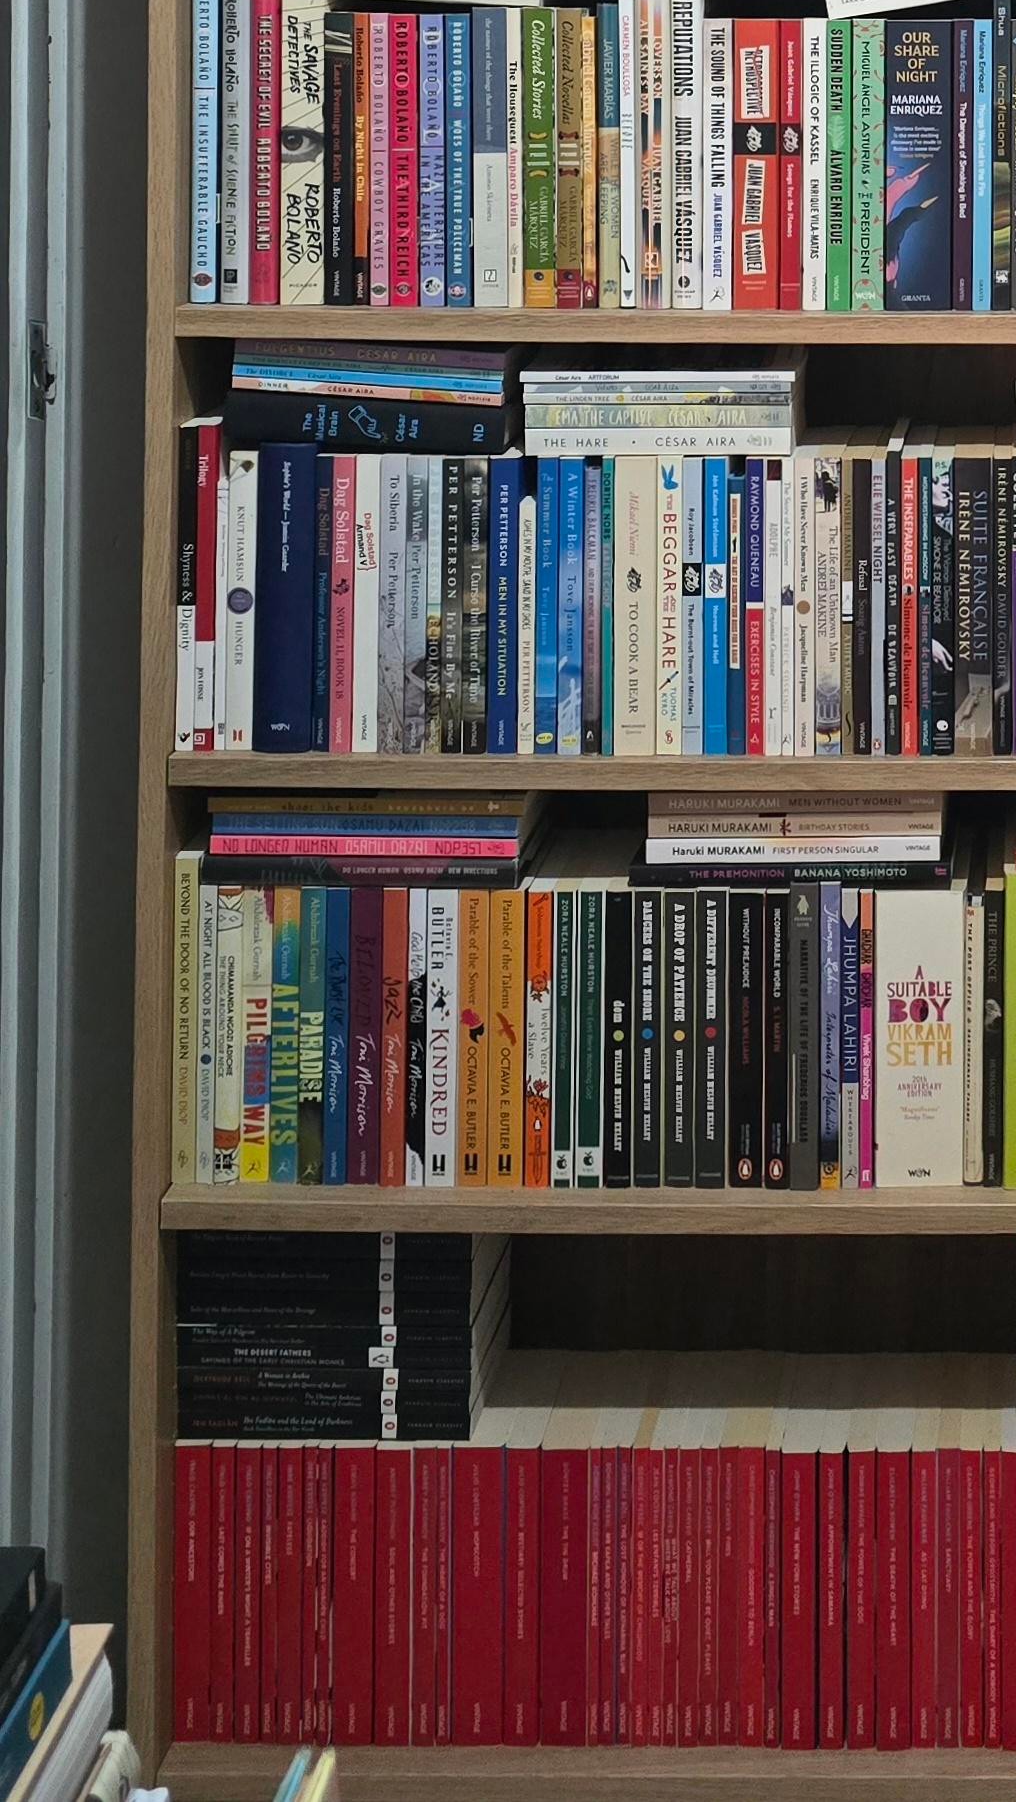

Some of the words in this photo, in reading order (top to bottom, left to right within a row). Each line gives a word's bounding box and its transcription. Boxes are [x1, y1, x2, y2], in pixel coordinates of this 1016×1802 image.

[902, 32, 931, 44] OUR
[672, 1, 692, 97] REPUTATIONS
[894, 45, 940, 57] SHARE
[907, 58, 925, 70] OF
[895, 70, 938, 84] NIGHT
[891, 95, 941, 105] MARIANA
[890, 104, 943, 116] ENRIQUEZ
[674, 116, 693, 140] JUAN
[674, 144, 693, 195] GABRIEL
[673, 198, 693, 263] VÁSQUEZ
[543, 438, 568, 448] THE
[576, 437, 609, 448] HARE
[655, 435, 697, 448] CÉSAR
[706, 437, 736, 447] AIRA
[672, 845, 705, 856] Haruki
[707, 845, 765, 856] MURAKAMI
[887, 982, 952, 997] SUITABLE
[888, 999, 948, 1023] BOY
[887, 1024, 952, 1041] VIKRAM
[887, 1043, 952, 1067] SETH
[430, 1029, 448, 1136] KINDRED
